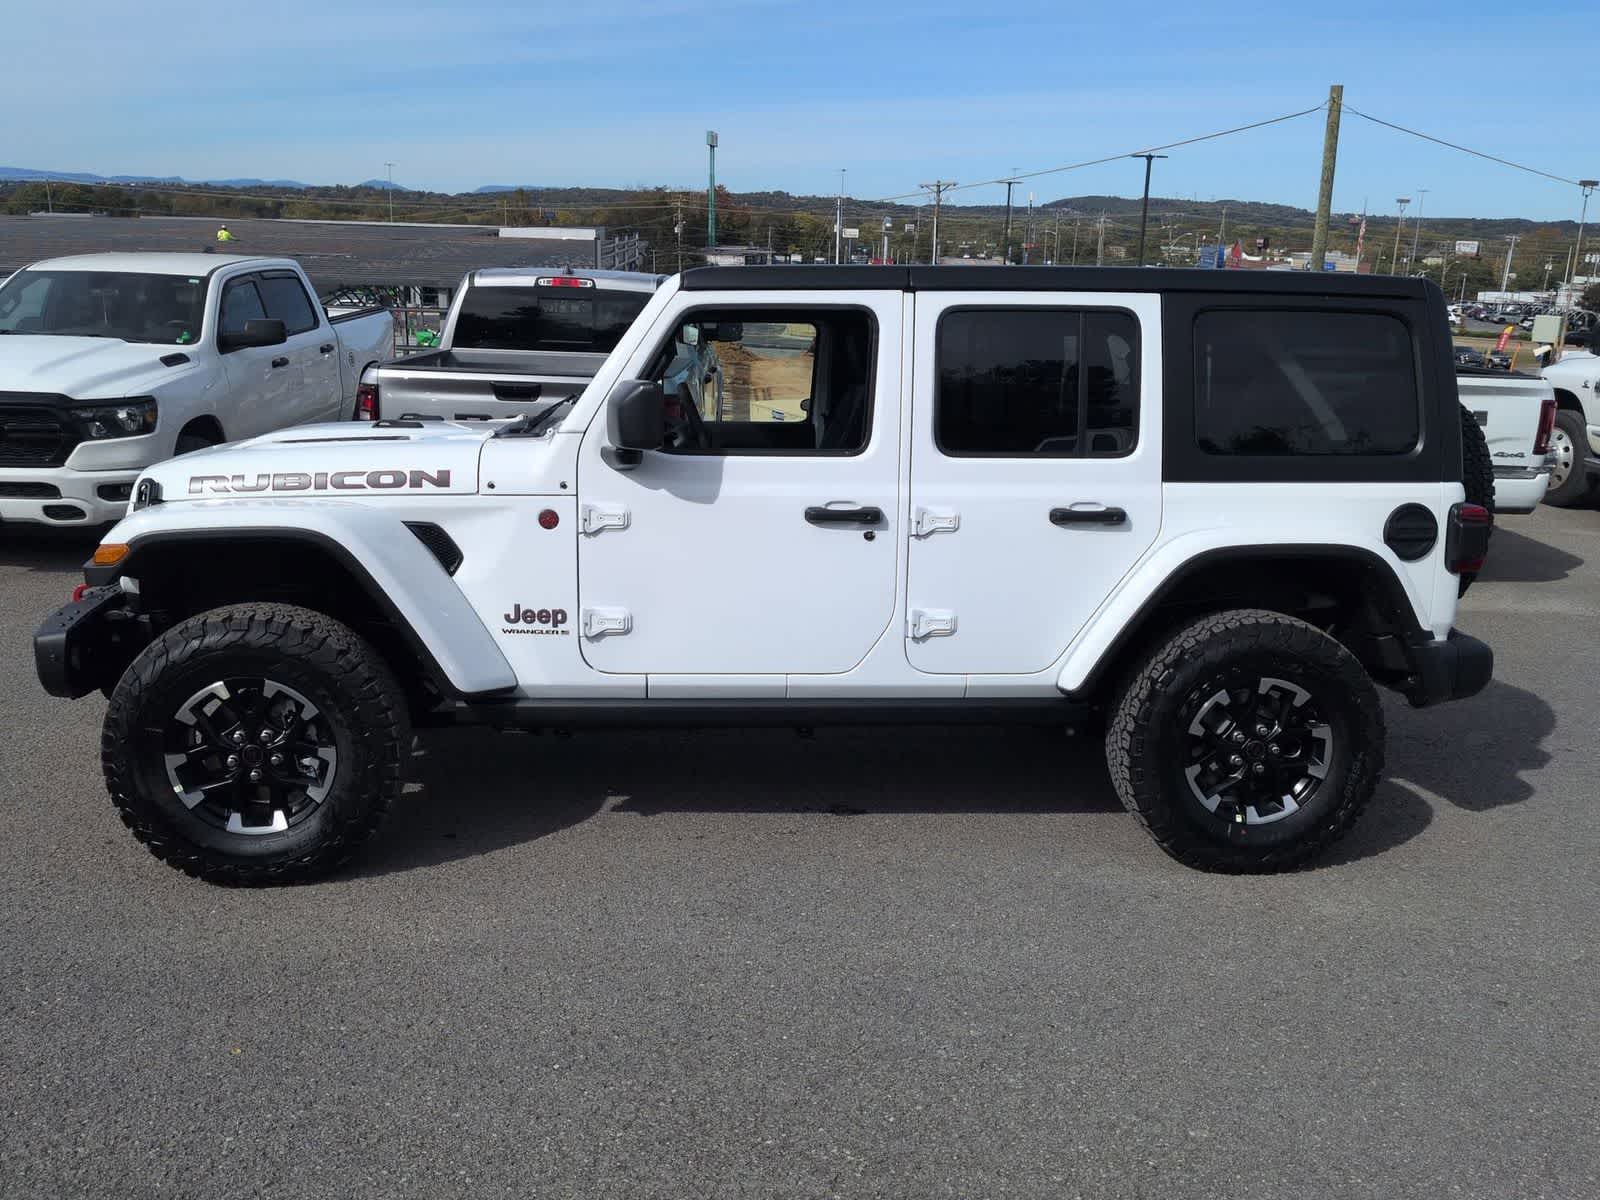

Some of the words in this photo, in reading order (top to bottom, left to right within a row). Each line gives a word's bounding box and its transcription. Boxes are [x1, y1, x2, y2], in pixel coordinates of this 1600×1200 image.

[188, 469, 451, 494] RUBICON
[503, 603, 567, 628] Jeep
[502, 628, 559, 636] WRANGLER
